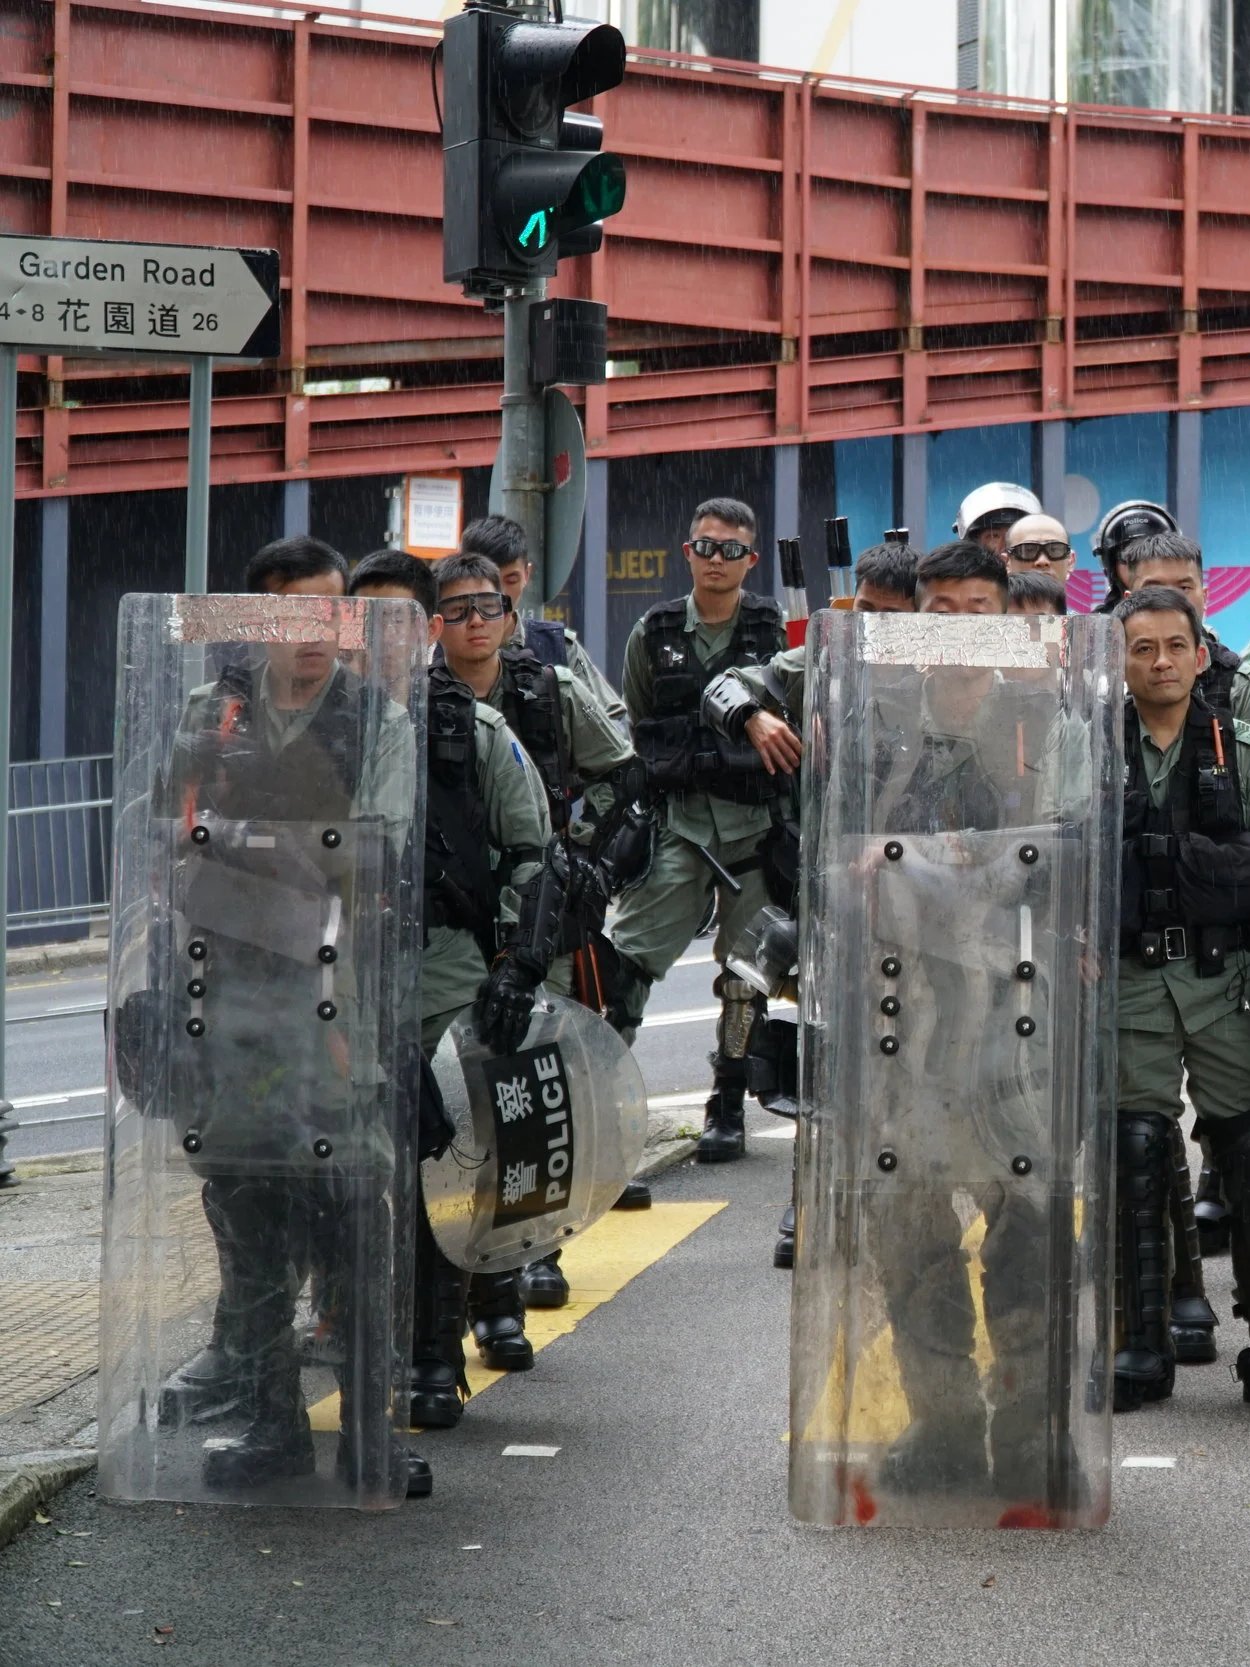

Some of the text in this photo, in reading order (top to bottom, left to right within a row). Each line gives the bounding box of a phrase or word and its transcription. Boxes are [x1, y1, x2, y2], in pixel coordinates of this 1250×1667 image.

[19, 251, 215, 287] Garden Road
[32, 303, 44, 322] 8
[57, 298, 181, 338] 花園道
[192, 313, 219, 331] 26
[607, 550, 668, 579] JECT
[496, 1076, 538, 1206] 警察
[533, 1053, 569, 1205] POLICE
